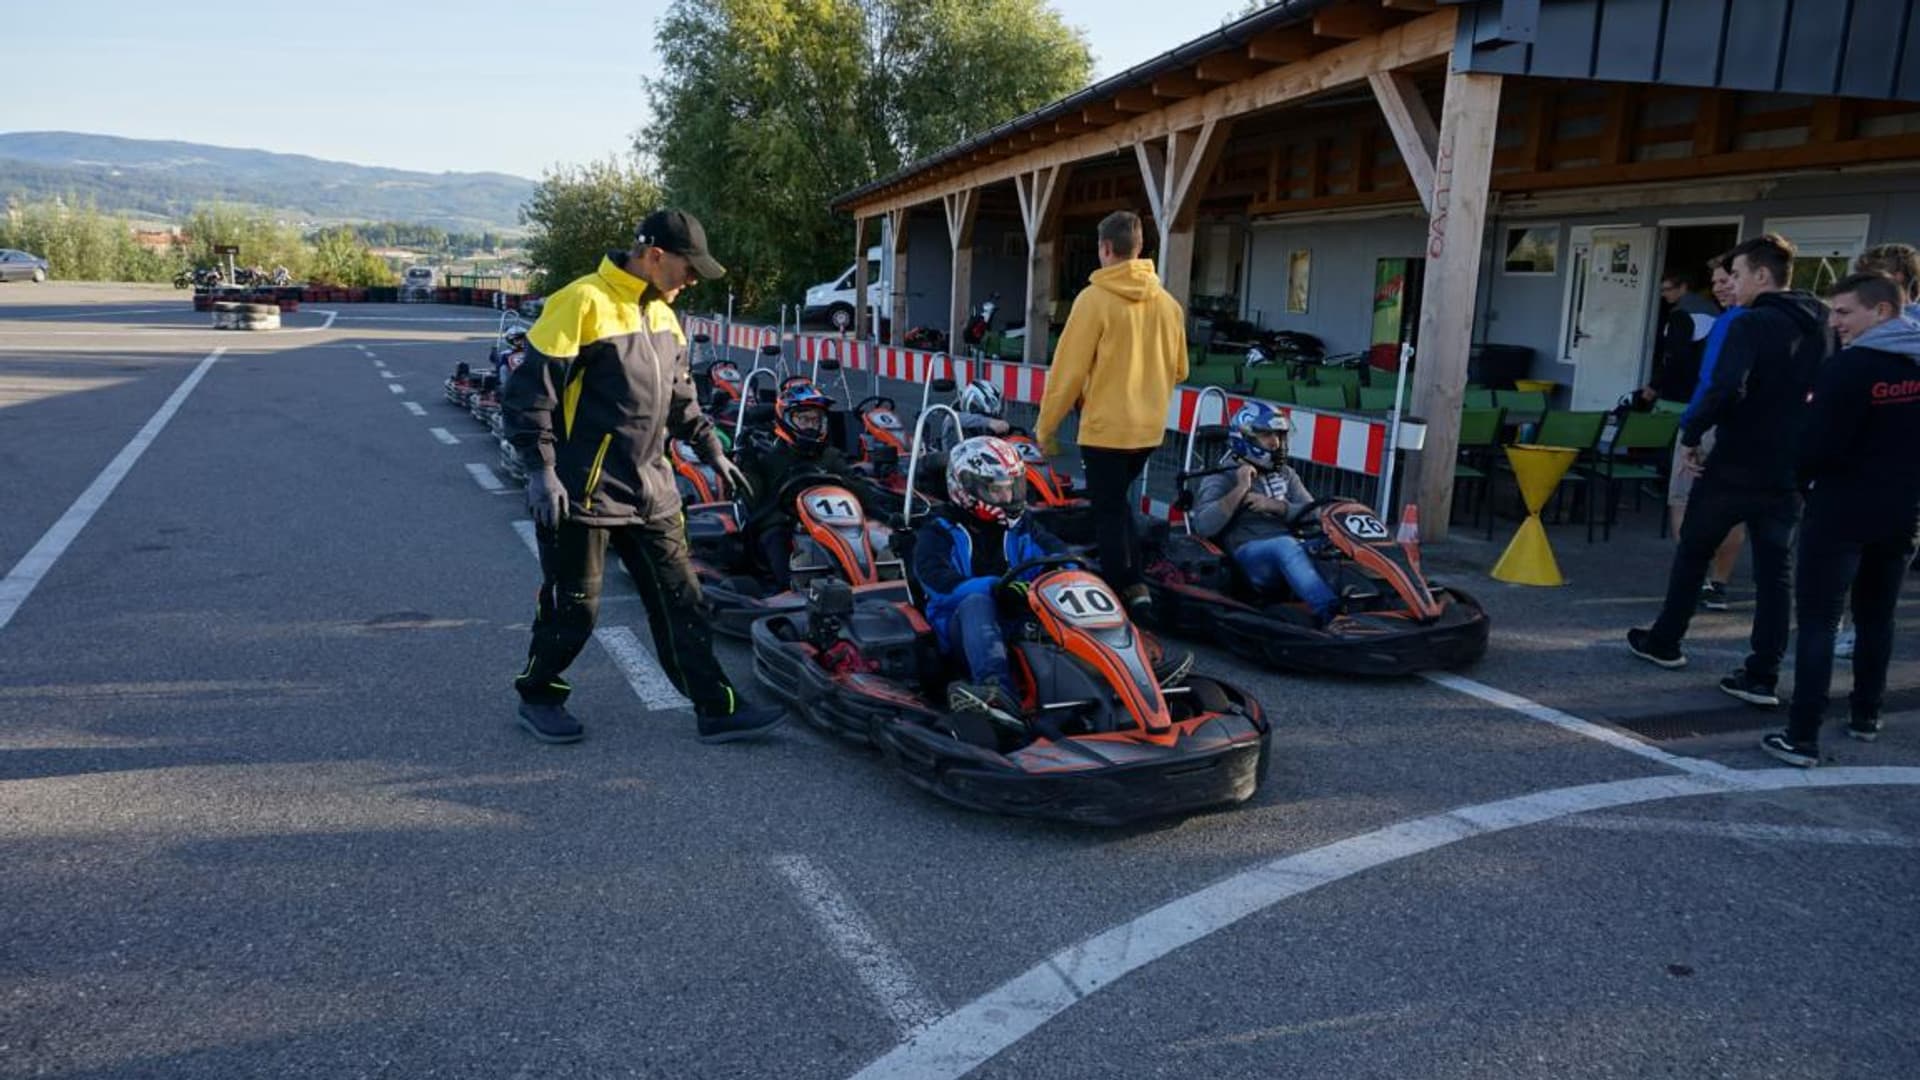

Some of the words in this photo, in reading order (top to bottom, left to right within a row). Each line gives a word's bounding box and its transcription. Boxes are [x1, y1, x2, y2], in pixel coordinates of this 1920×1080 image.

[816, 499, 854, 516] 11
[1348, 516, 1385, 534] 26
[1058, 588, 1115, 614] 10
